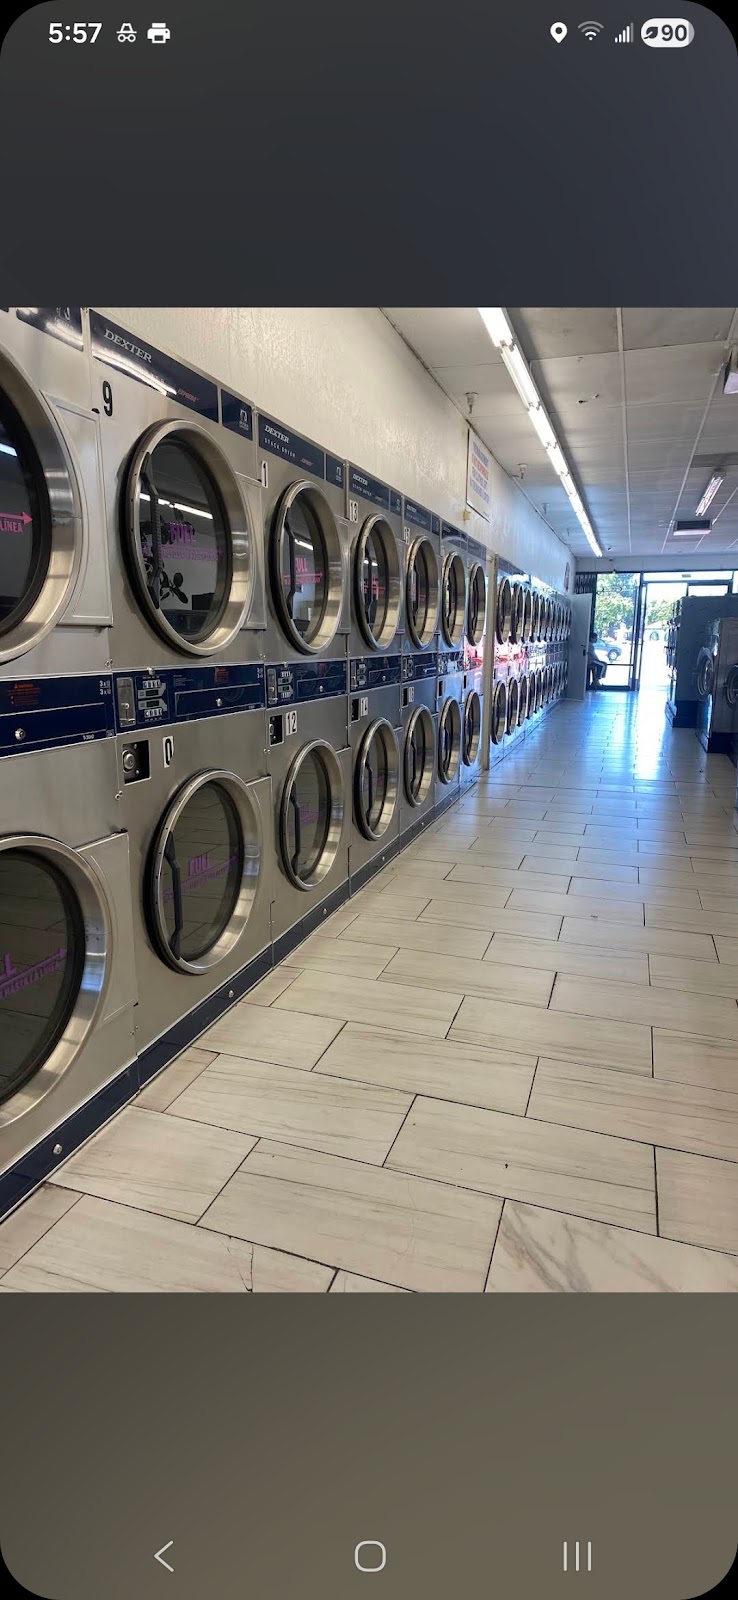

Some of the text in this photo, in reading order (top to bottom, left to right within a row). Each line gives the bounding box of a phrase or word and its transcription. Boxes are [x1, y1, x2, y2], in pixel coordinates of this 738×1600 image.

[104, 329, 153, 363] DEXTER
[102, 381, 113, 417] 9
[264, 424, 290, 444] DEXTER
[264, 437, 296, 459] STACK DRYER
[286, 711, 298, 735] 12
